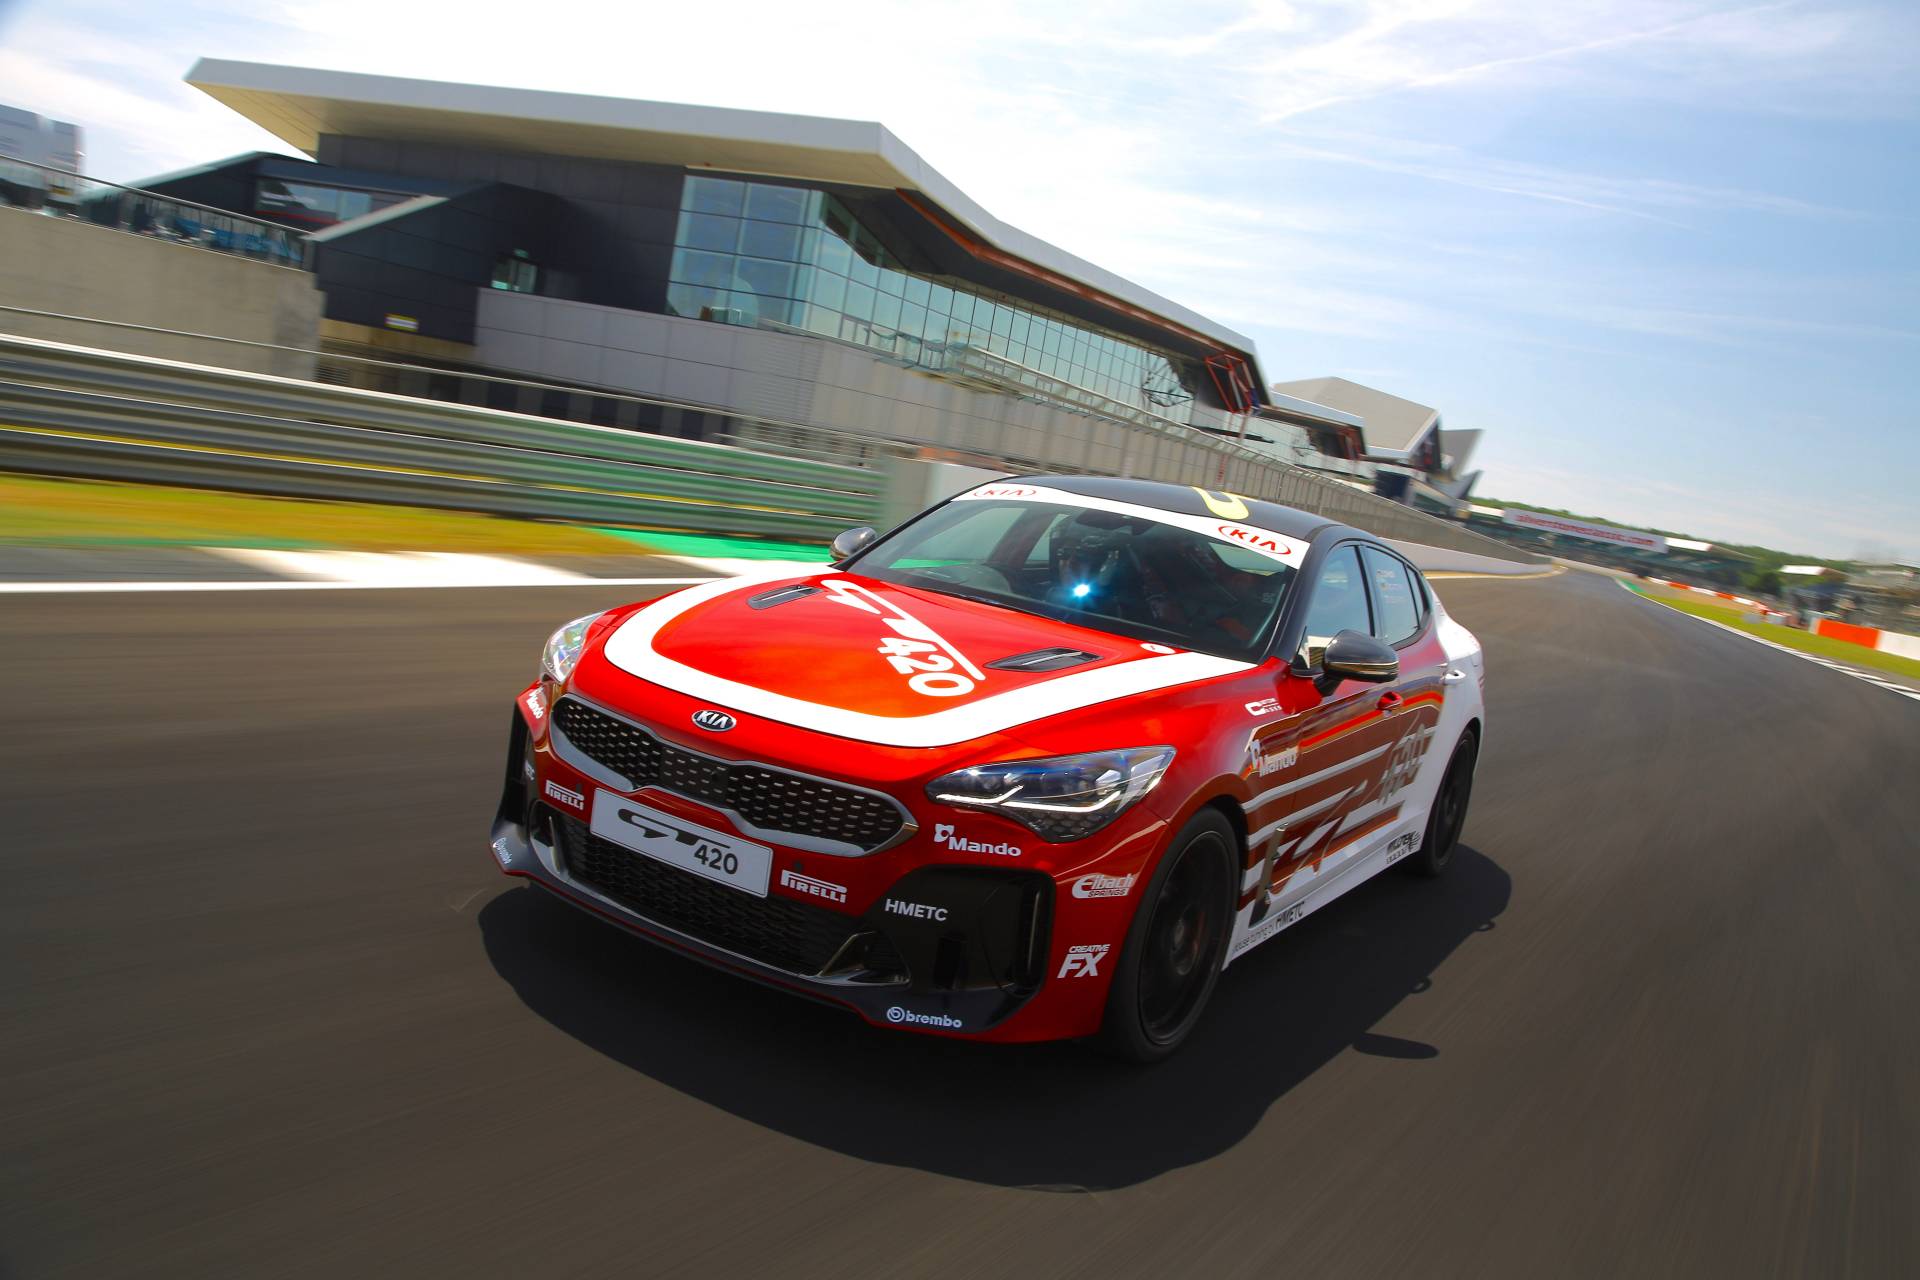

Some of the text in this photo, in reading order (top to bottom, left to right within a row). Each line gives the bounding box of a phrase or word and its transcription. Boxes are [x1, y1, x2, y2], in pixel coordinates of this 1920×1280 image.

[1229, 529, 1276, 551] KIA
[876, 637, 976, 697] 420
[695, 709, 728, 729] KIA
[545, 779, 584, 811] PIRELLI
[948, 837, 1022, 857] Mando
[693, 844, 740, 876] 420
[780, 869, 848, 903] PIRELLI
[1088, 888, 1127, 898] SPRINGS
[885, 898, 949, 921] HMETC
[1068, 943, 1111, 954] CREATIVE
[1057, 951, 1108, 979] FX
[904, 1009, 963, 1029] brembo
